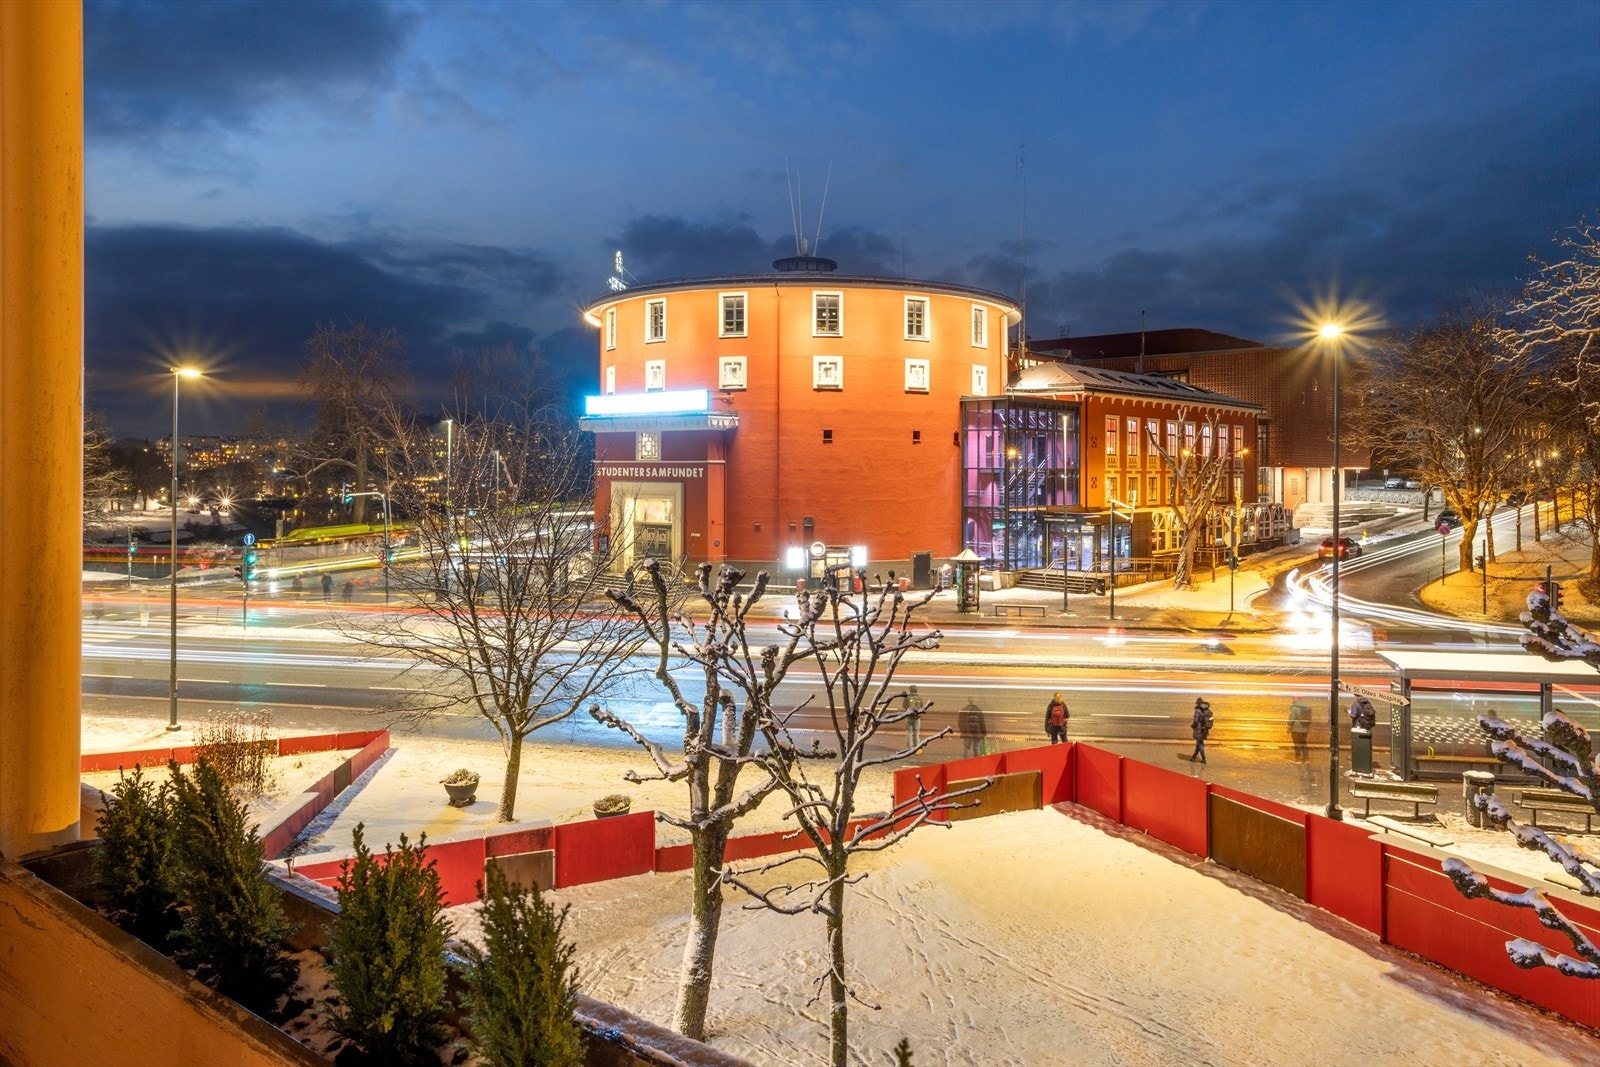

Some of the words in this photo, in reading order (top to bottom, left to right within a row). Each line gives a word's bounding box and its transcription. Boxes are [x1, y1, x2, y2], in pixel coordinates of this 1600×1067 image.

[597, 467, 704, 478] STUDENTERSAMFUNDET
[1361, 688, 1377, 698] Olavs
[1378, 693, 1402, 704] Hospital
